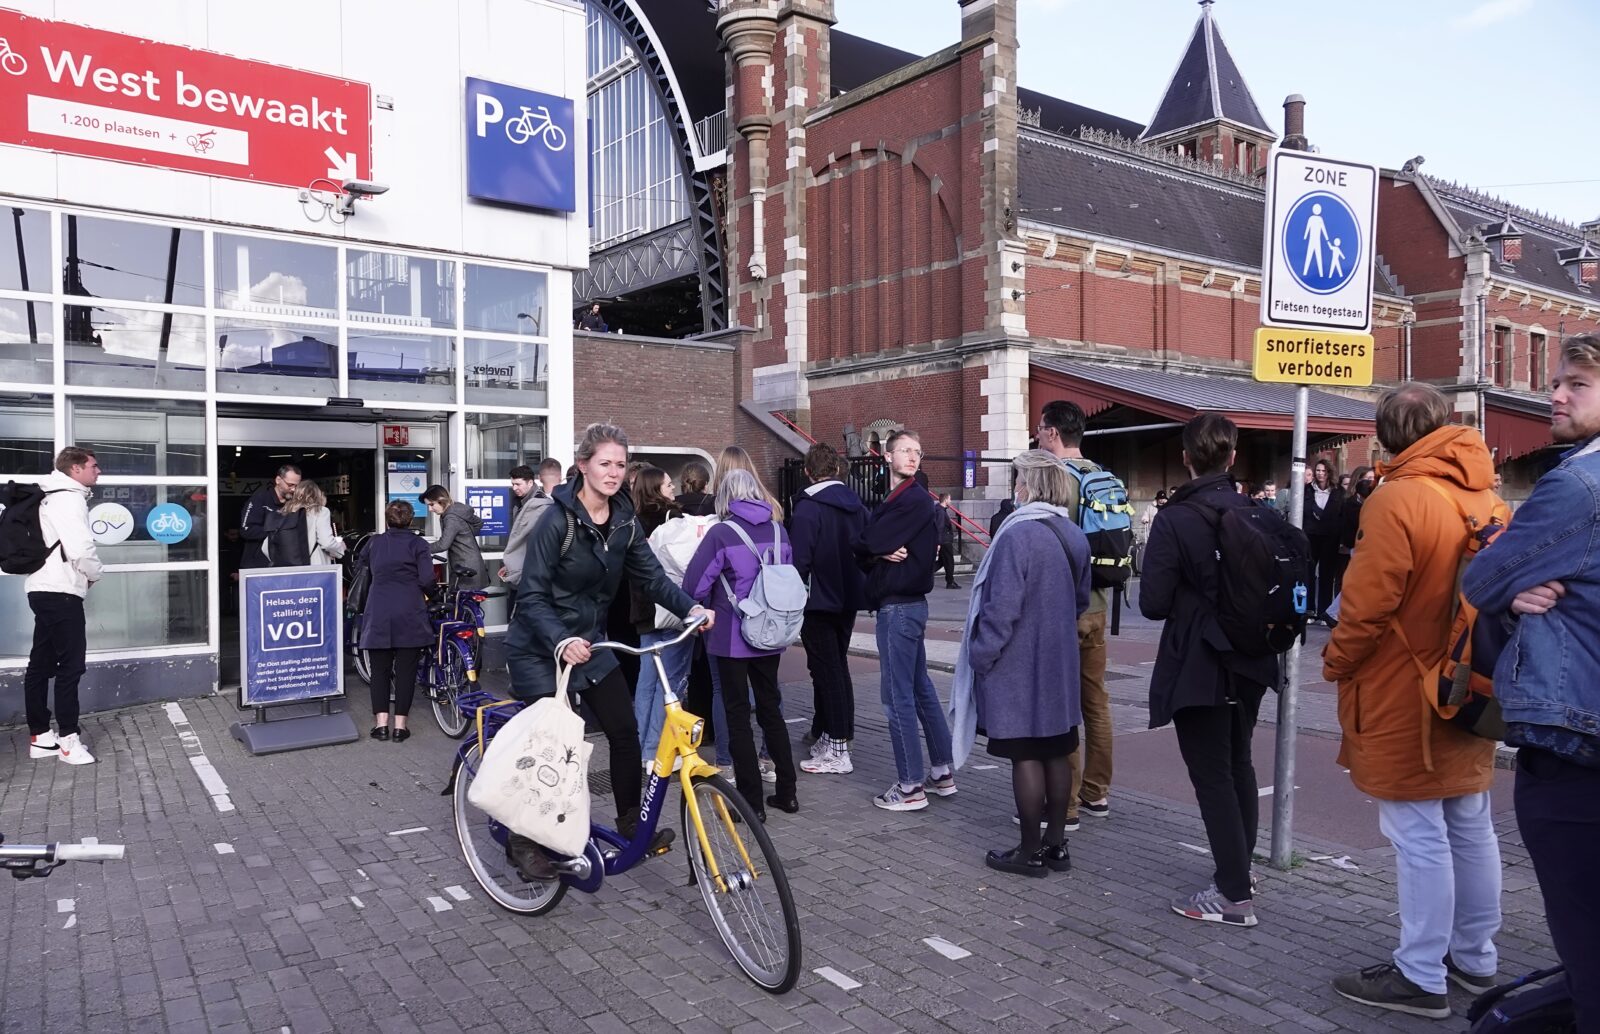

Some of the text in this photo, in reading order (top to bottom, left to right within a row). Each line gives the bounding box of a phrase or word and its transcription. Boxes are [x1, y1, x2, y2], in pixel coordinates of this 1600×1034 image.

[40, 46, 348, 135] West bewaakt
[476, 93, 504, 137] P
[60, 112, 100, 130] 1.200
[104, 120, 160, 140] plaatsen
[1304, 166, 1348, 187] ZONE
[1274, 300, 1363, 319] Fietsen toegestaan
[1266, 337, 1365, 357] snorfietsers
[1278, 360, 1352, 378] verboden
[266, 596, 318, 607] Helaas, deze
[272, 609, 303, 618] stalling
[267, 620, 318, 641] VOL
[278, 681, 306, 689] voldoende
